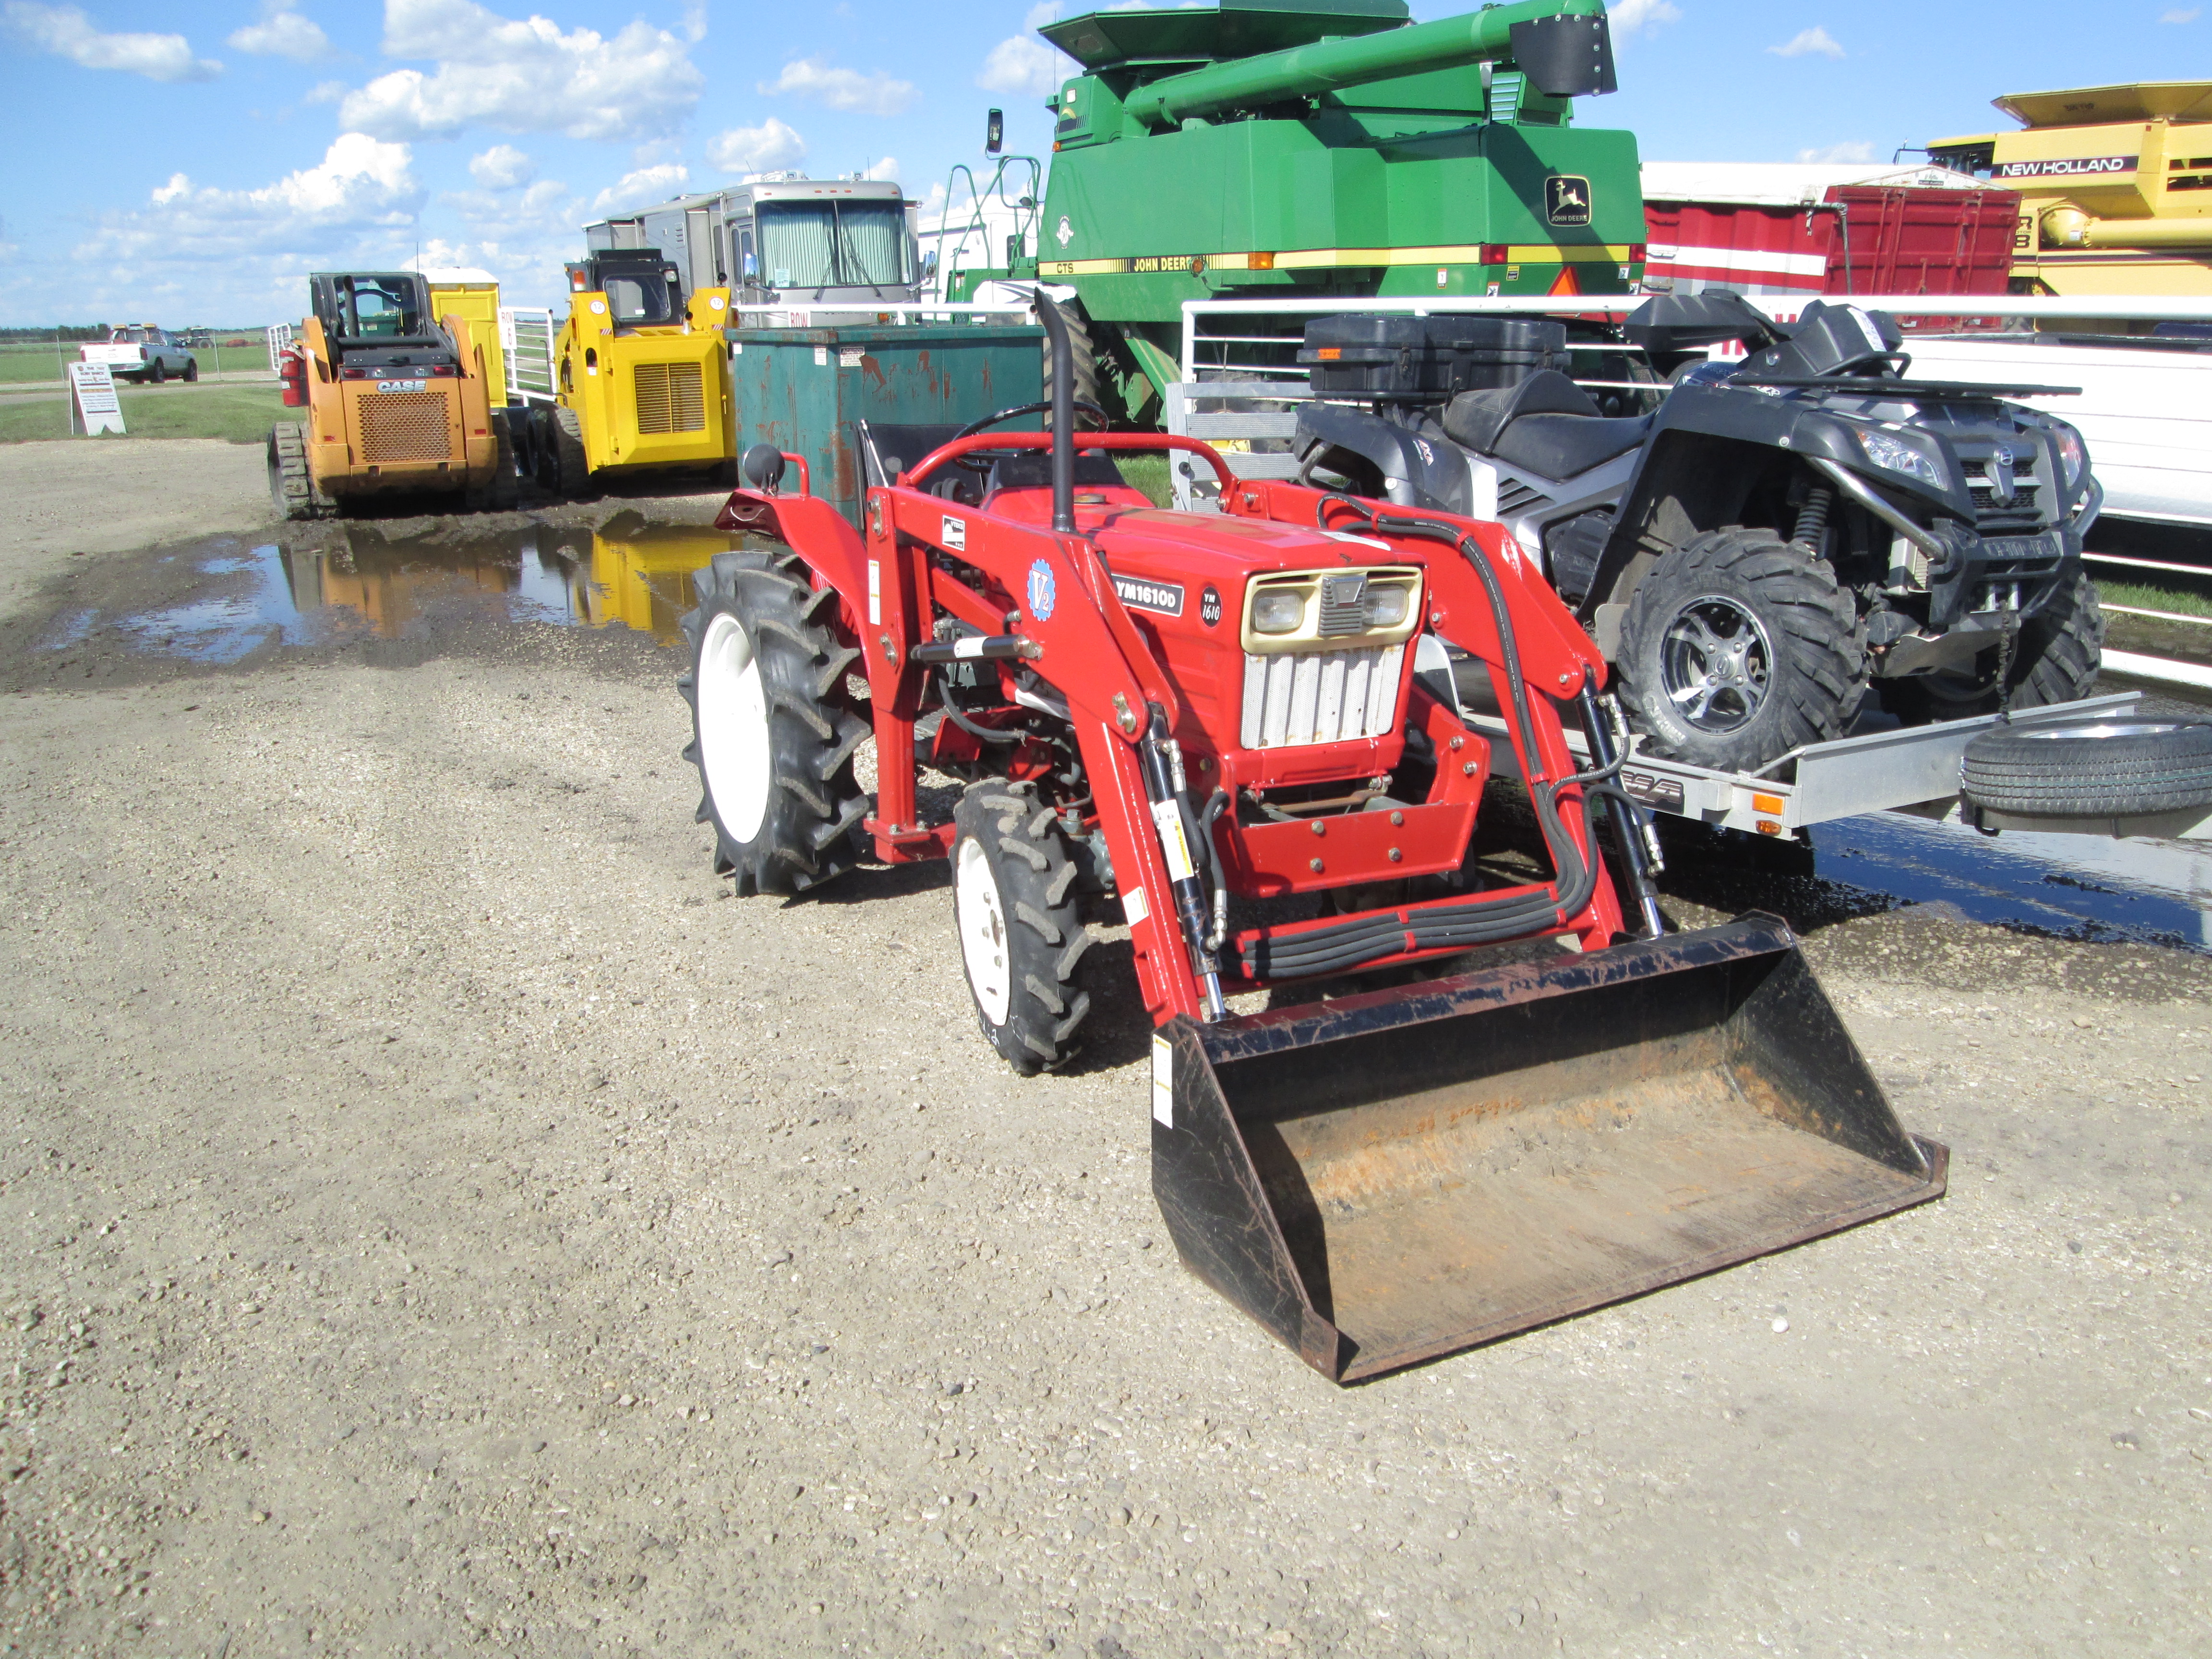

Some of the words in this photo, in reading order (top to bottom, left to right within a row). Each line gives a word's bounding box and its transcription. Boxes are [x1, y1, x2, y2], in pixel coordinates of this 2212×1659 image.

[2002, 163, 2040, 177] NEW
[2042, 158, 2124, 175] HOLLAND
[1057, 263, 1074, 274] CTS
[1134, 258, 1158, 272] JOHN
[501, 311, 513, 324] ROW
[790, 312, 808, 327] ROW
[507, 327, 512, 346] 6
[377, 380, 427, 393] CASE
[1116, 581, 1176, 608] YM1610D
[1204, 593, 1216, 603] YM
[1202, 604, 1220, 621] 1610
[1578, 769, 1606, 778] RESISTANT
